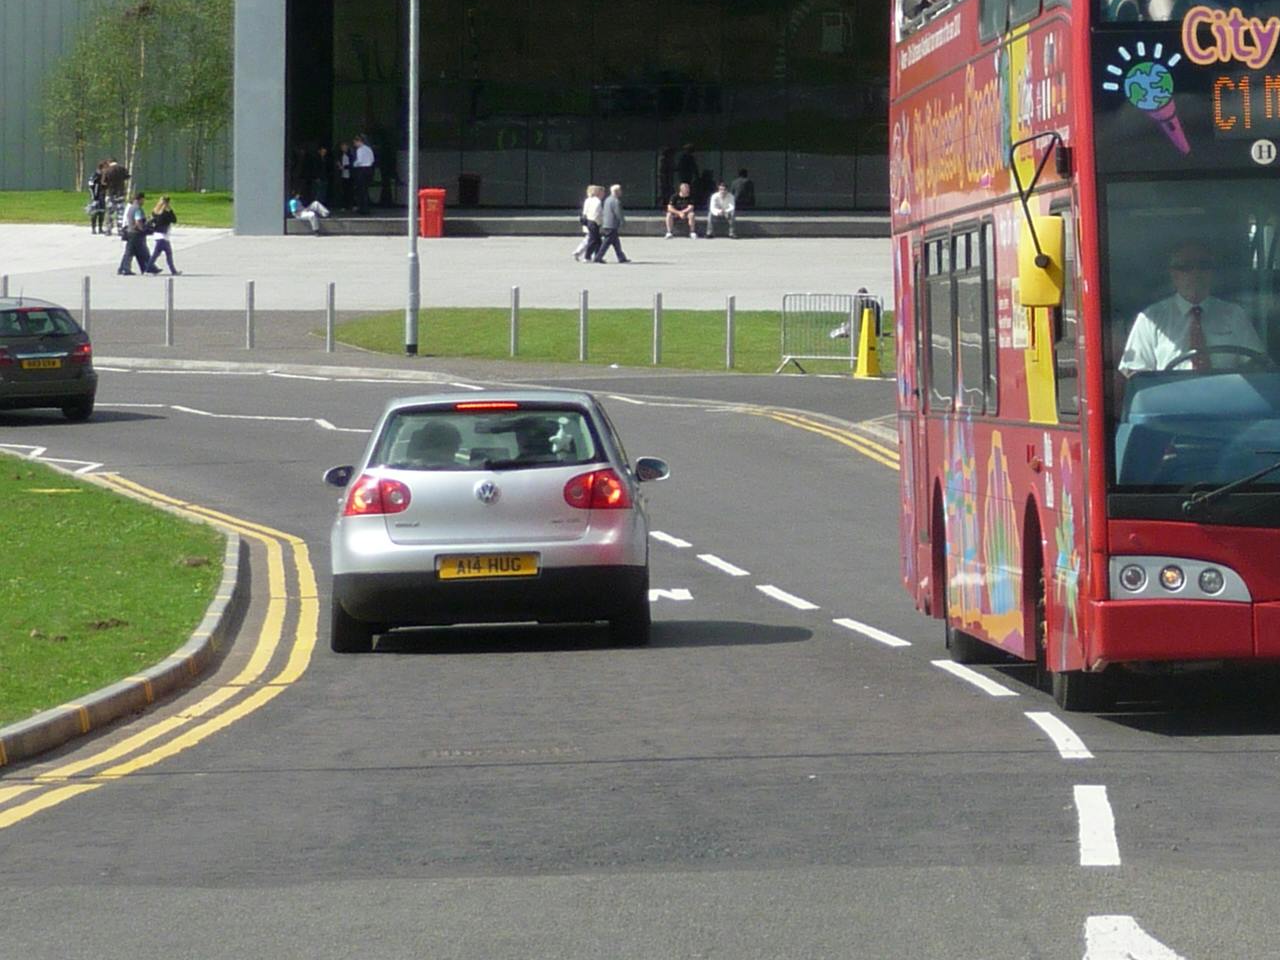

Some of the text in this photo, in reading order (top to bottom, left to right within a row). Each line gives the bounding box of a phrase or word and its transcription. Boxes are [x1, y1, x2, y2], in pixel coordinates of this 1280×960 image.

[1182, 6, 1280, 69] City
[1214, 75, 1251, 130] C1
[456, 556, 522, 576] A14 HUG
